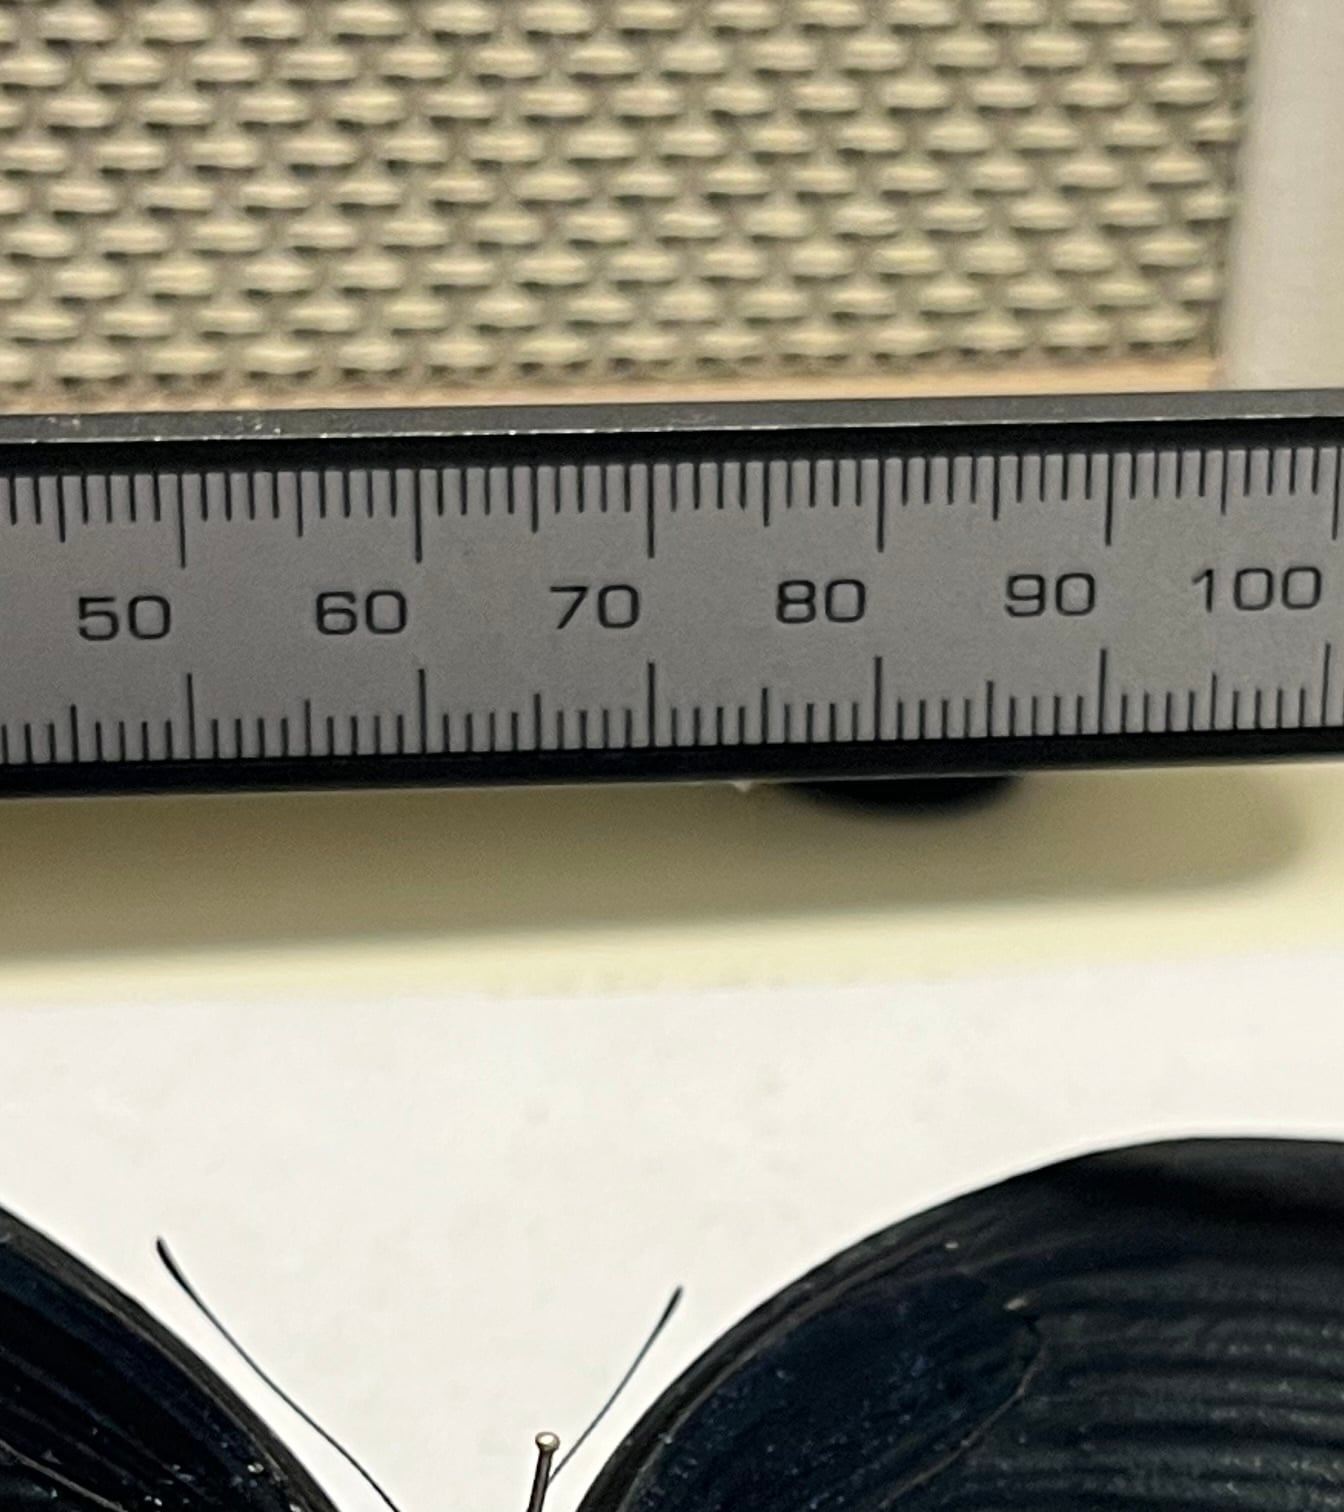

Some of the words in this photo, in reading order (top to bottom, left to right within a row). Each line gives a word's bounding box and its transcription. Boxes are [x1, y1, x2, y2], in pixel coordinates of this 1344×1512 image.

[77, 594, 172, 642] 50
[315, 589, 408, 636] 60
[549, 583, 640, 630] 70
[776, 578, 867, 625] 80
[1004, 572, 1096, 618] 90
[1192, 565, 1323, 613] 100
